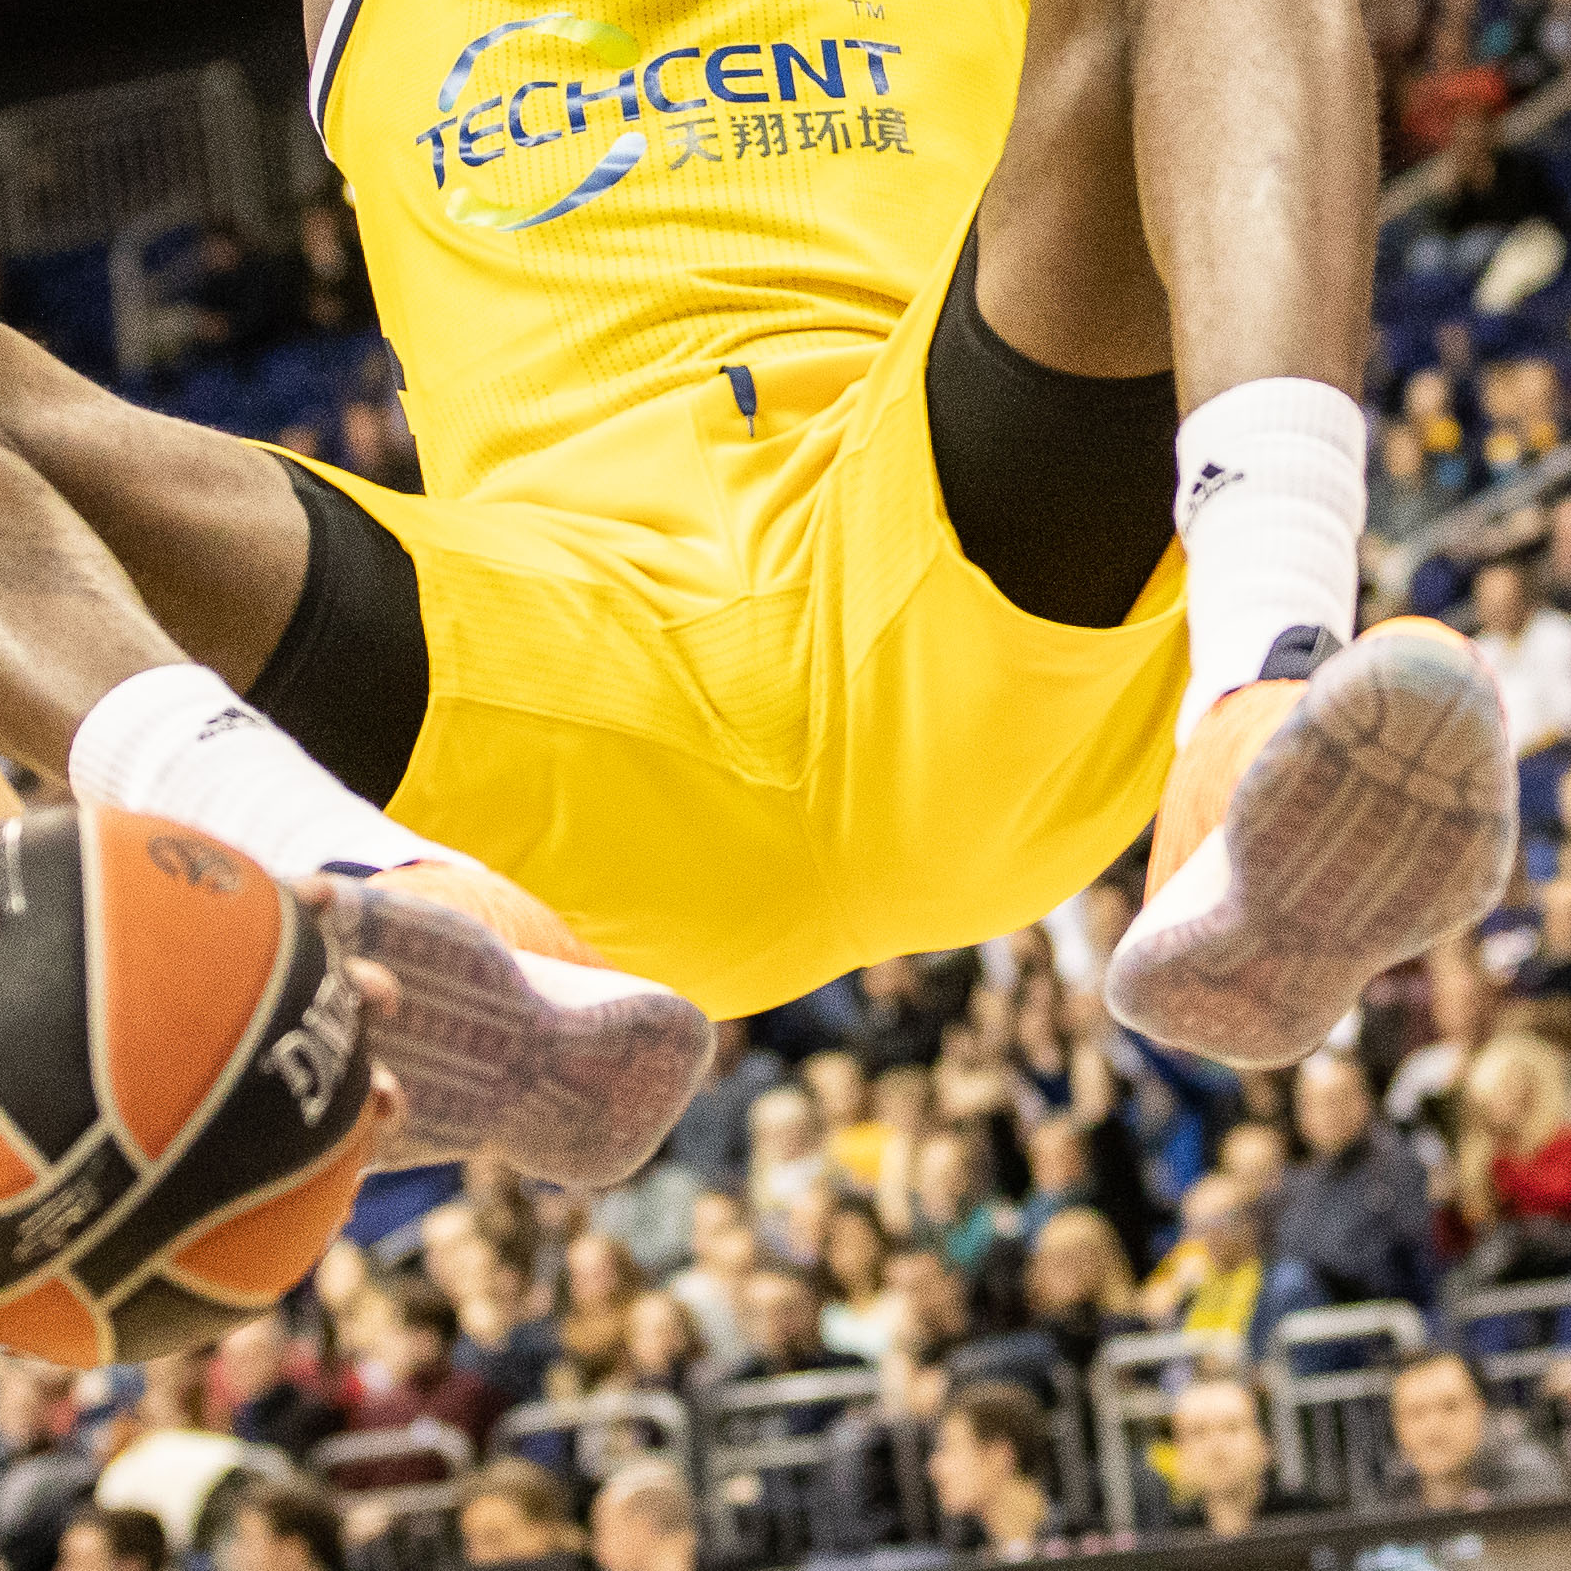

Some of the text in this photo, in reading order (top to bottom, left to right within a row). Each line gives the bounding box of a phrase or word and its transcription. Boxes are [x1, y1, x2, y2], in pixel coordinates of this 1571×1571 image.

[416, 39, 901, 190] TECHCENT
[666, 106, 915, 171] 天翔环境
